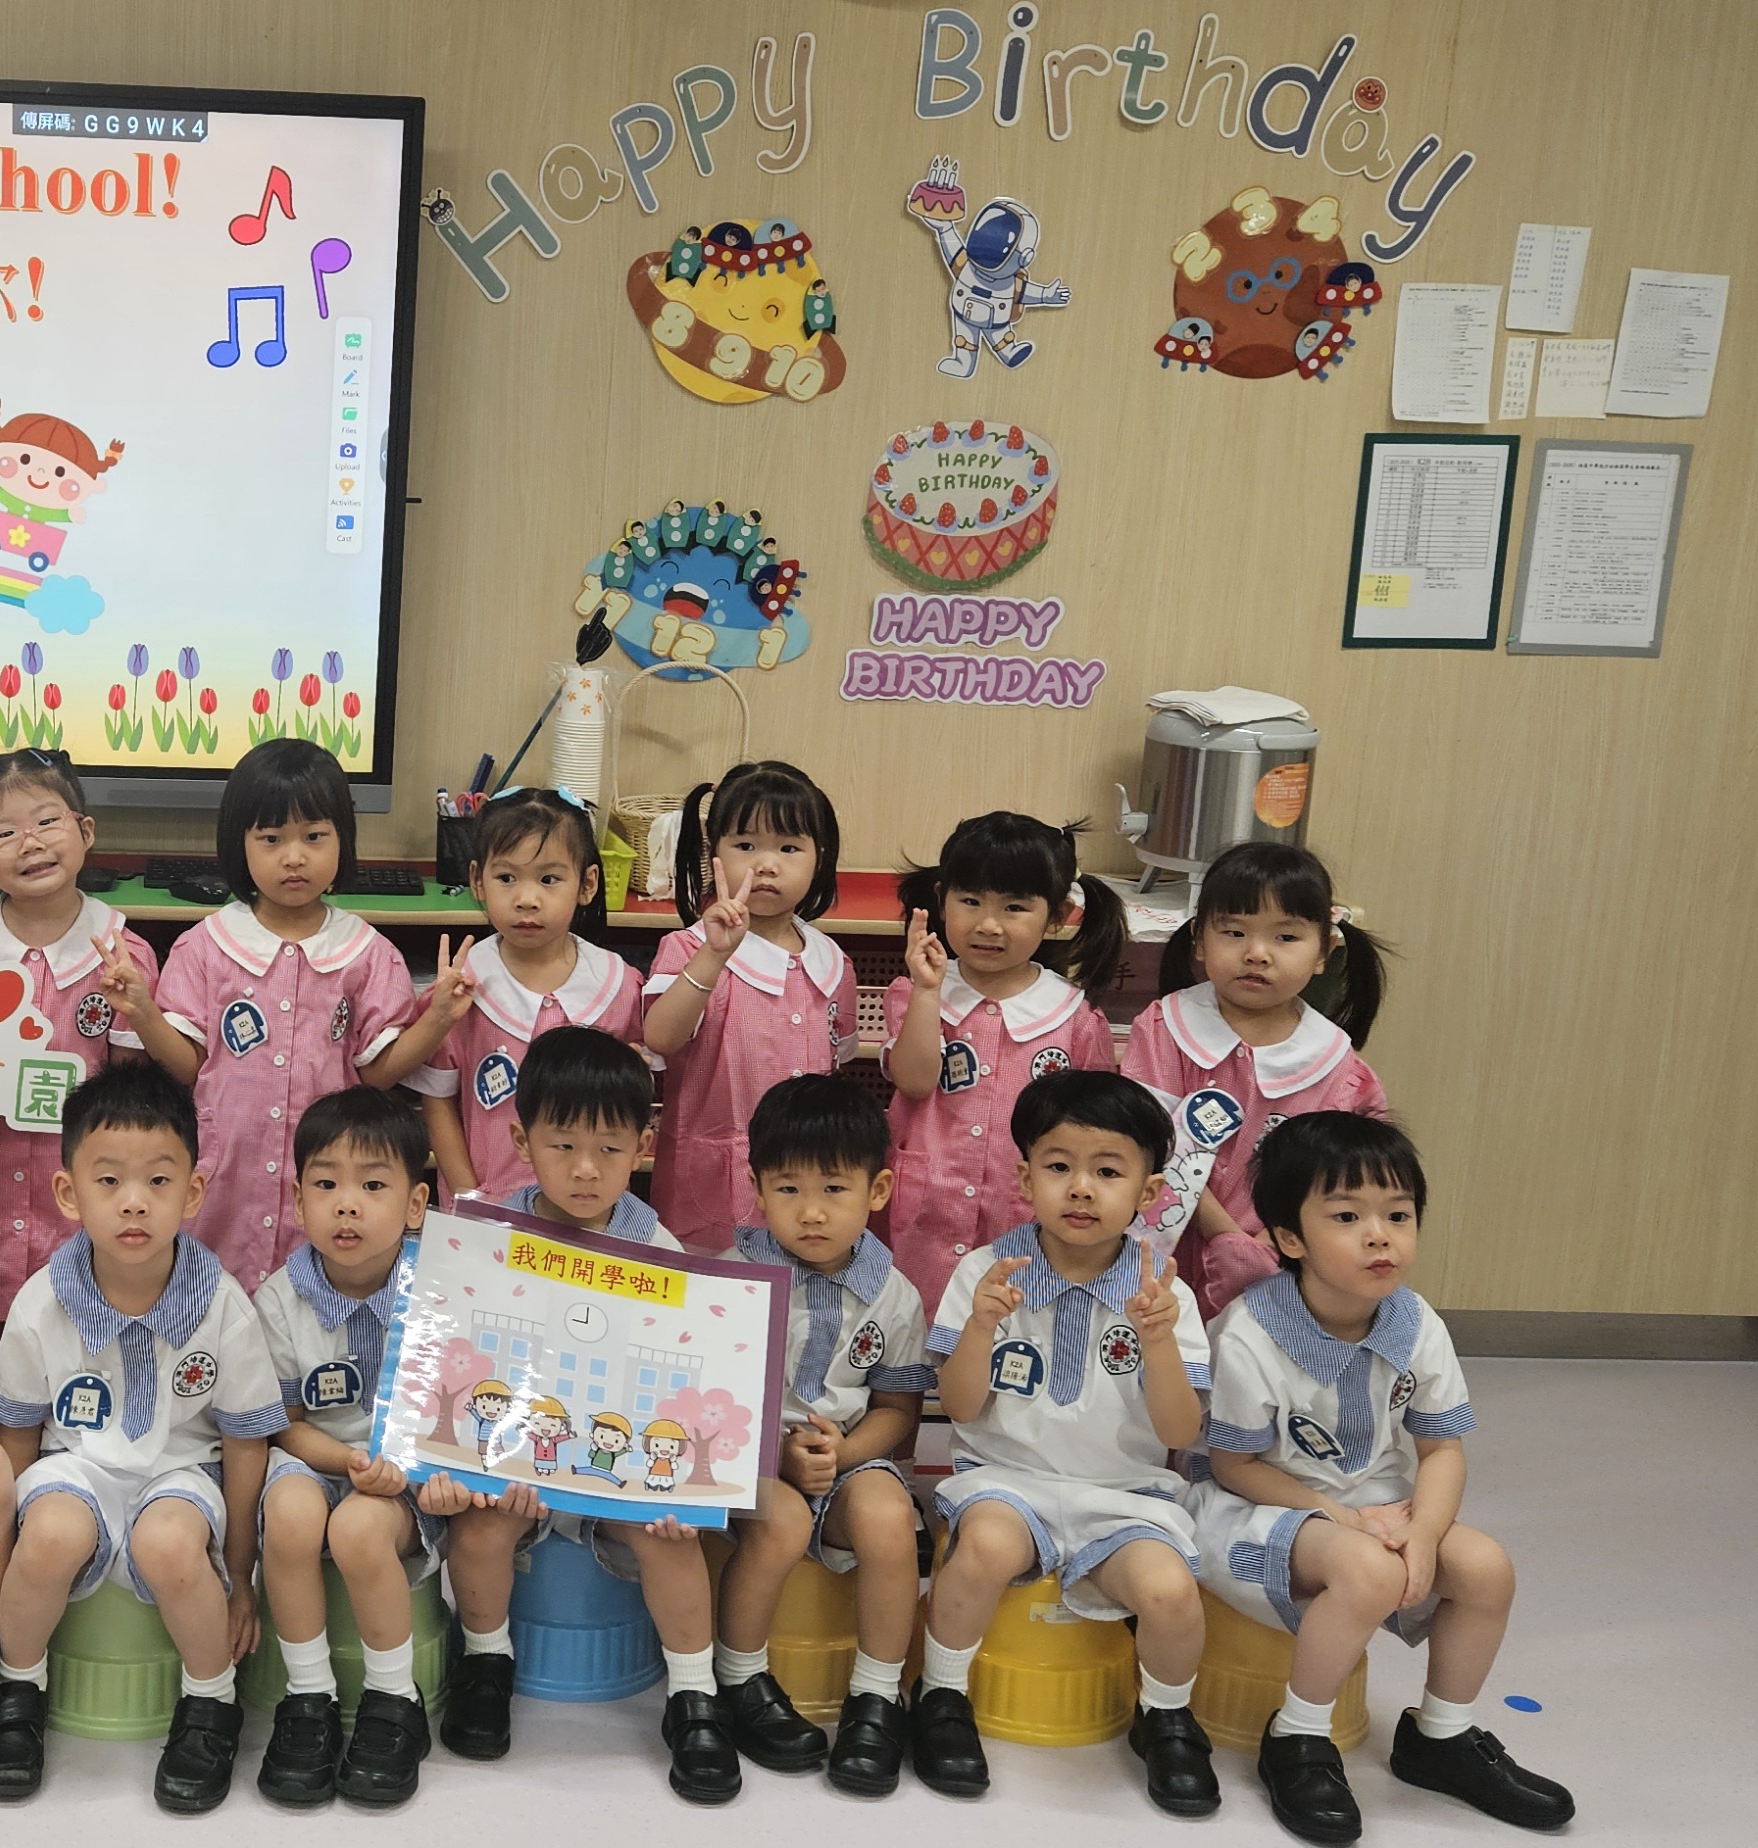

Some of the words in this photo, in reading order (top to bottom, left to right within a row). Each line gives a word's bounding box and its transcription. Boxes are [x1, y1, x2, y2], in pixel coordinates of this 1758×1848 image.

[915, 0, 1476, 264] Birthday
[651, 300, 697, 349] 8
[342, 354, 363, 362] Board
[708, 332, 753, 380] 9
[764, 344, 826, 403] 10
[342, 390, 360, 398] Mark
[341, 426, 358, 435] Files
[335, 463, 360, 472] Upload
[937, 451, 1003, 470] HAPPY
[917, 472, 1015, 494] BIRTHDAY
[330, 499, 362, 507] Activities
[336, 535, 352, 543] Cast
[874, 595, 1061, 648] HAPPY
[846, 655, 1103, 709] BIRTHDAY
[512, 1241, 670, 1299] 我們開學啦!
